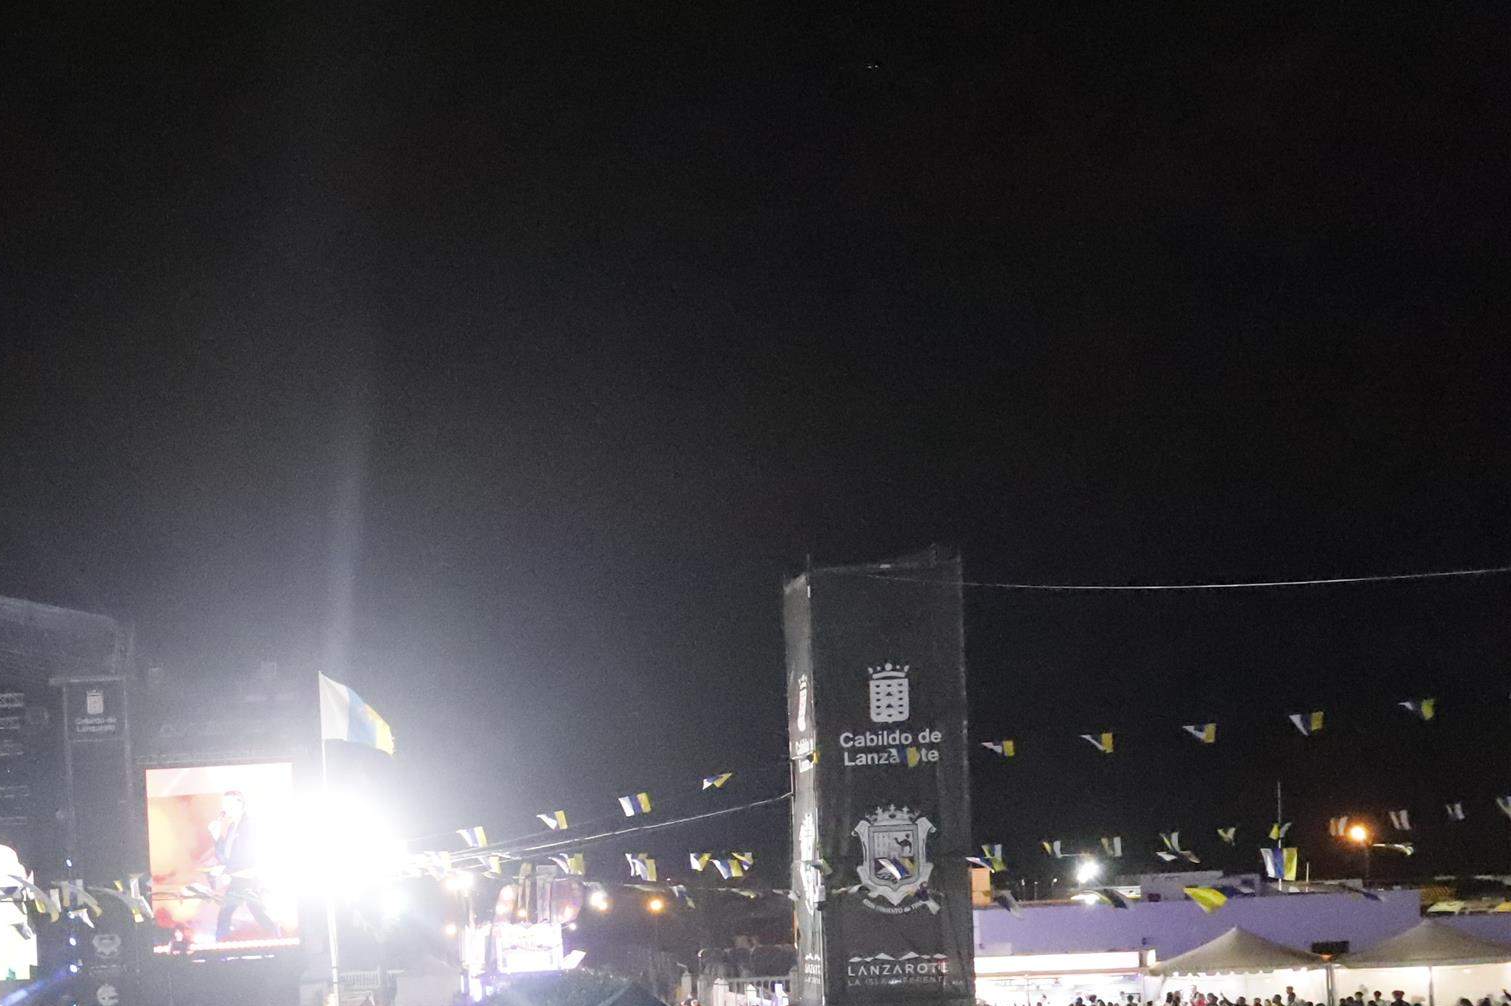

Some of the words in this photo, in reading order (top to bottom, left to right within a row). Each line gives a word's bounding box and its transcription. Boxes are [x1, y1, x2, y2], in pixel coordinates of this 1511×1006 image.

[839, 730, 912, 748] Cabildo
[918, 728, 942, 744] de
[843, 747, 940, 767] Lanzate
